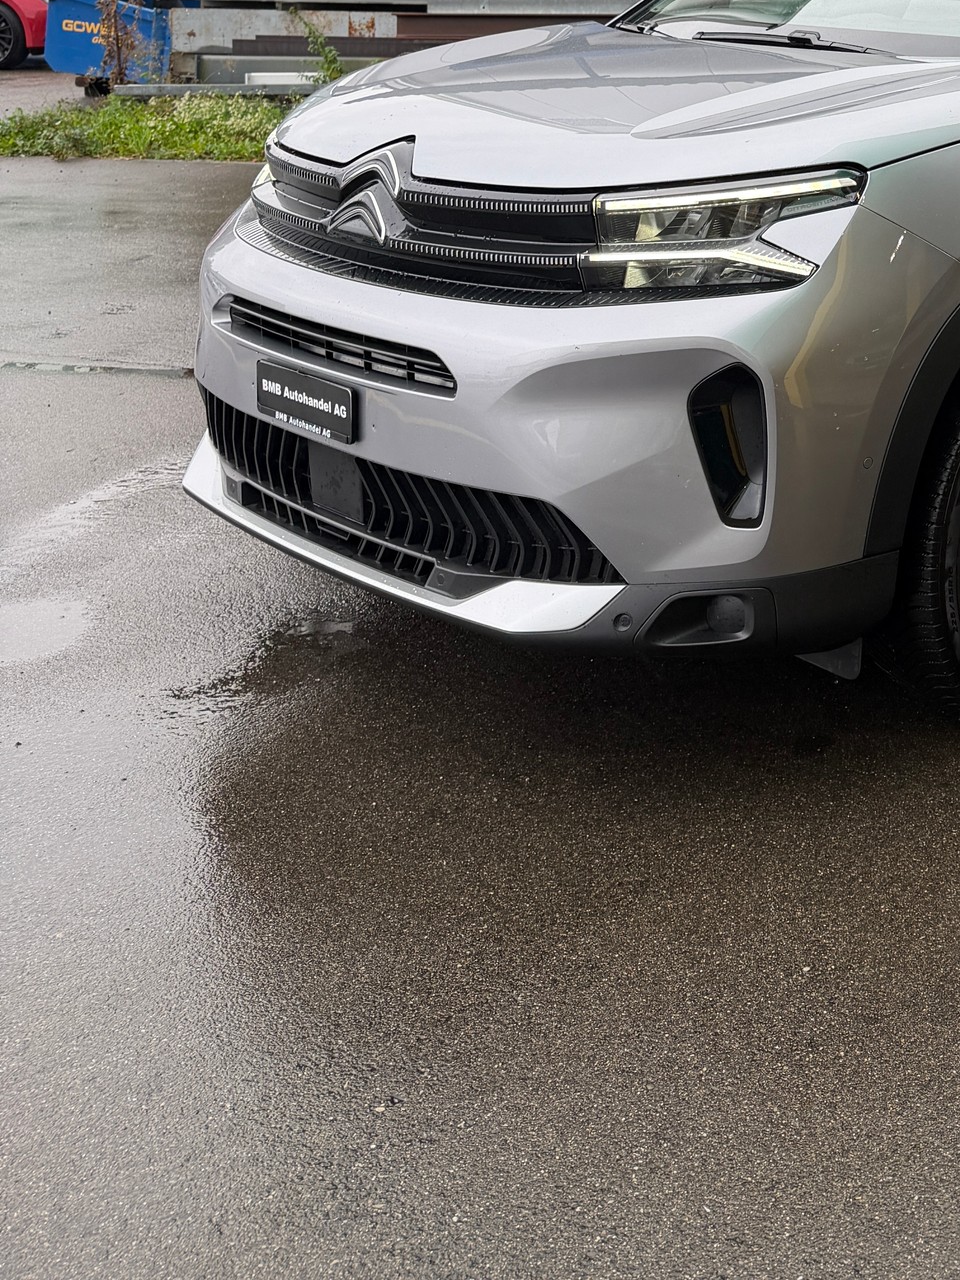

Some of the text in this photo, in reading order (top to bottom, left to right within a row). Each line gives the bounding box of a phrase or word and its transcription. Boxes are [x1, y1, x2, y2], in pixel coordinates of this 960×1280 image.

[262, 379, 347, 419] BMB Autohandel AG
[275, 411, 331, 438] BMB Autohandel AG
